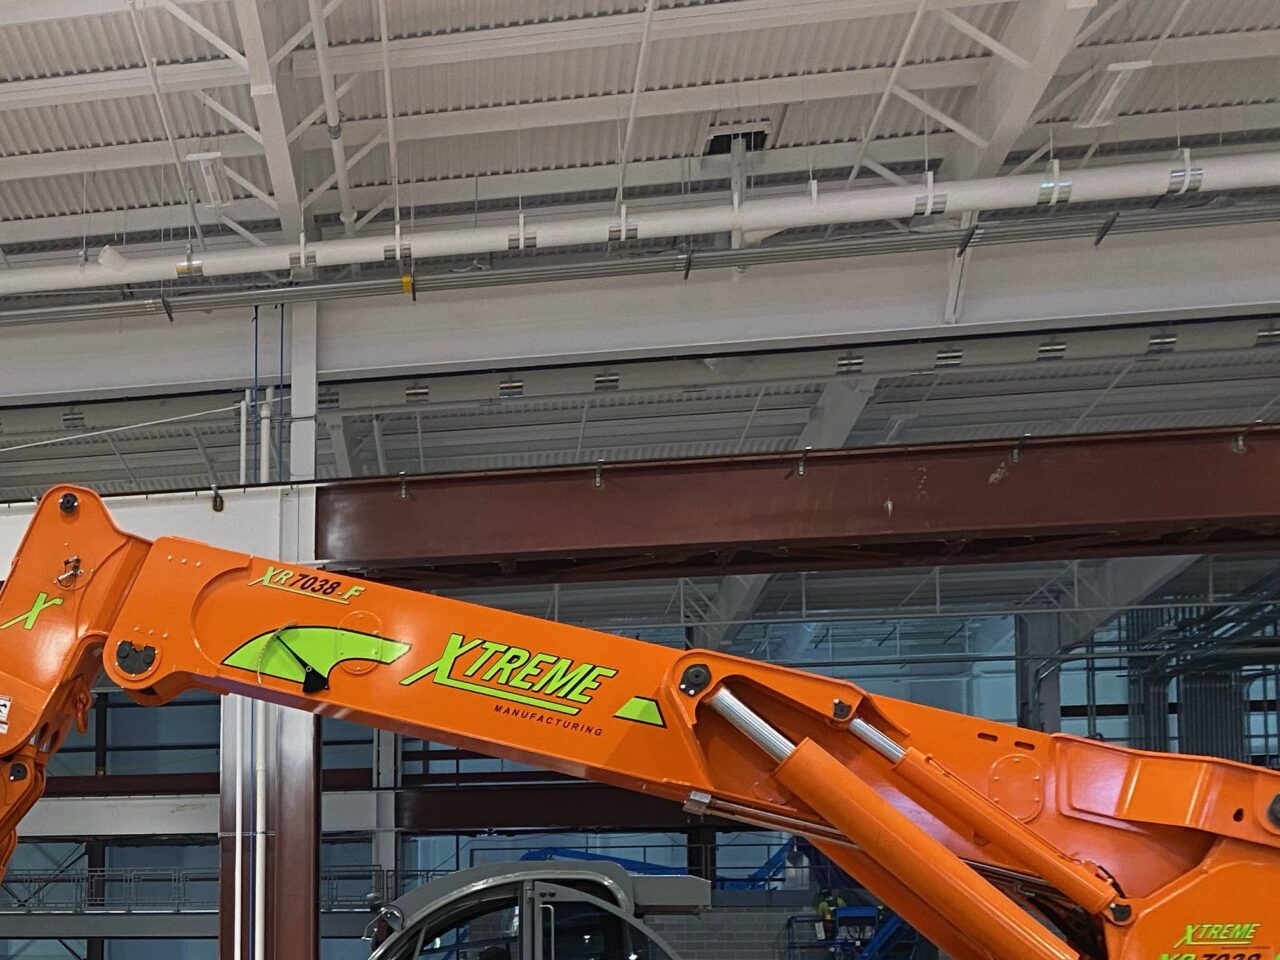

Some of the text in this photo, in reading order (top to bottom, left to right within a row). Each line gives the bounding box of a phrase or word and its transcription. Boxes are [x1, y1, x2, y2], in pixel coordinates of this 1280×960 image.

[399, 633, 619, 711] XTREME
[493, 704, 603, 737] MANUFACTURING
[1172, 923, 1261, 948] XTREME
